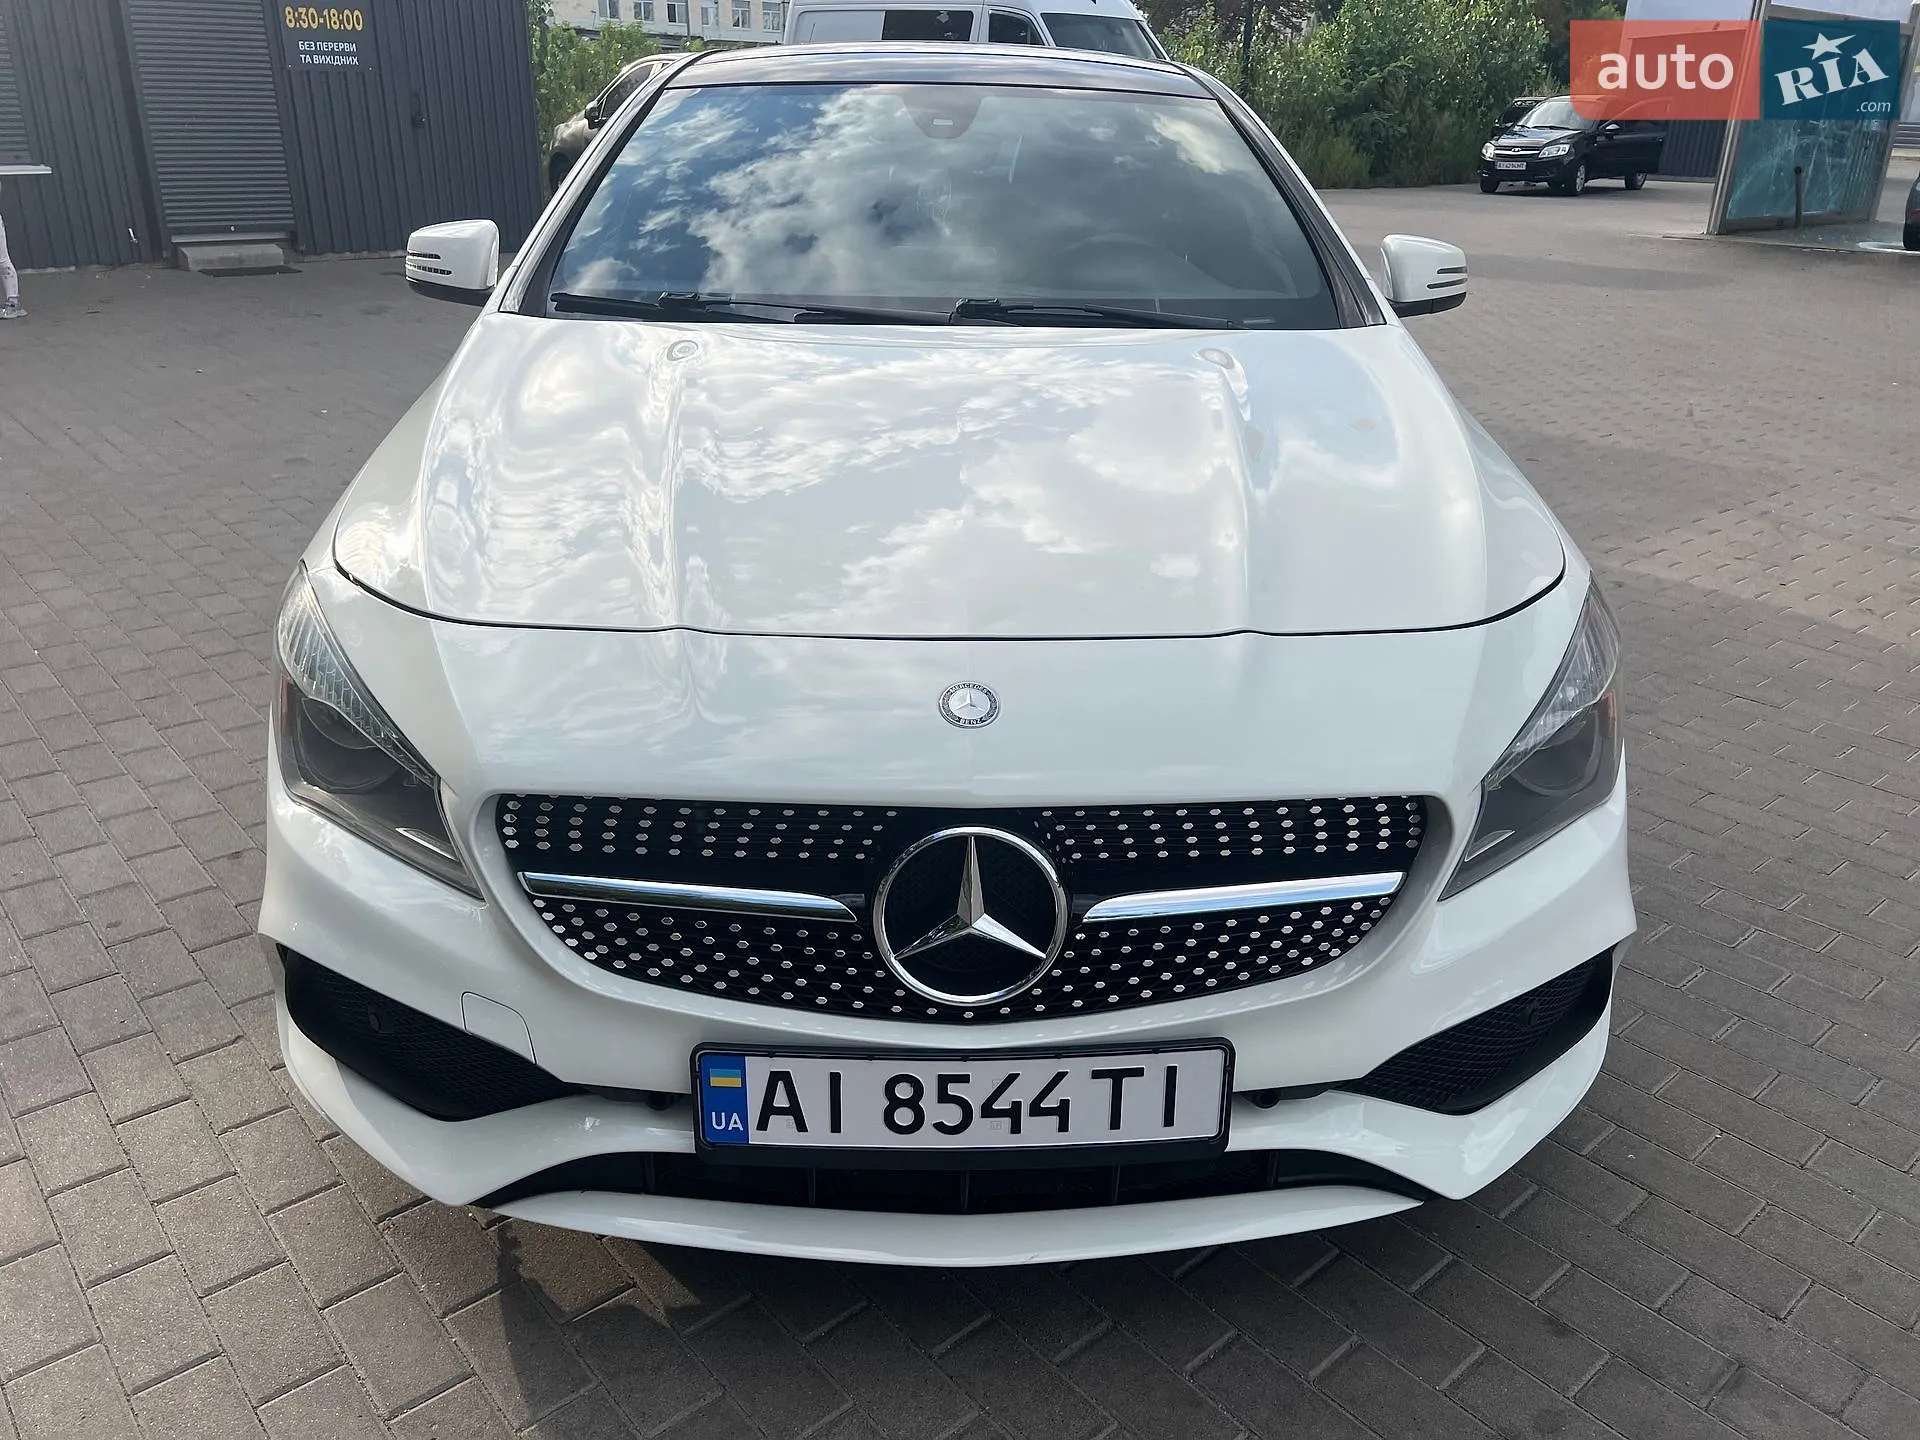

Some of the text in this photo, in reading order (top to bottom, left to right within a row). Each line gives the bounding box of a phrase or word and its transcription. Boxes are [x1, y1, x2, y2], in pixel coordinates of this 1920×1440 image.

[284, 6, 363, 31] 8:30-18:00
[298, 41, 357, 52] БЕЗ ПЕРЕРВИ
[300, 54, 359, 66] ТА ВИХІДНИХ
[755, 1065, 1178, 1135] AI 8544 TI
[711, 1112, 744, 1132] UA
